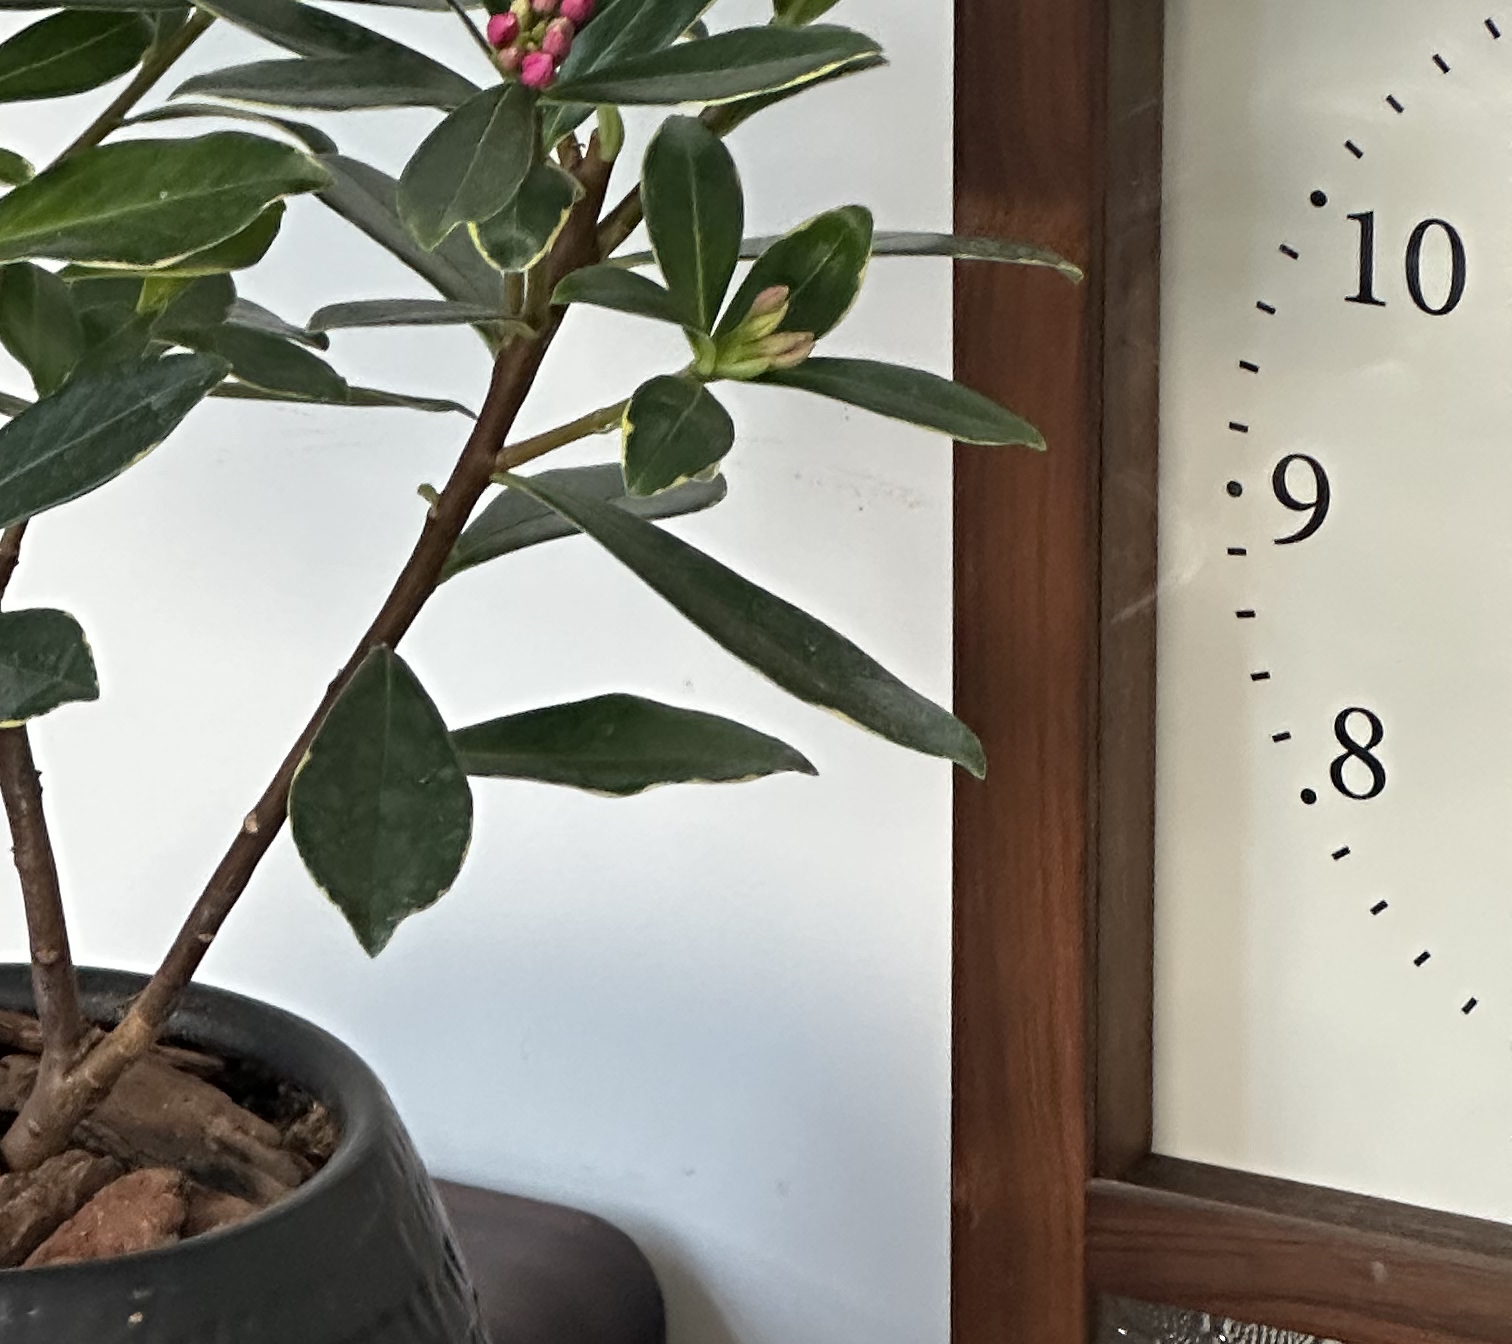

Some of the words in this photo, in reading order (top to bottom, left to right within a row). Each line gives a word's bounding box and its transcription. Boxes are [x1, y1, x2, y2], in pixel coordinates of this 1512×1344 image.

[1344, 210, 1467, 316] 10
[1271, 453, 1331, 545] 9
[1329, 706, 1387, 800] 8
